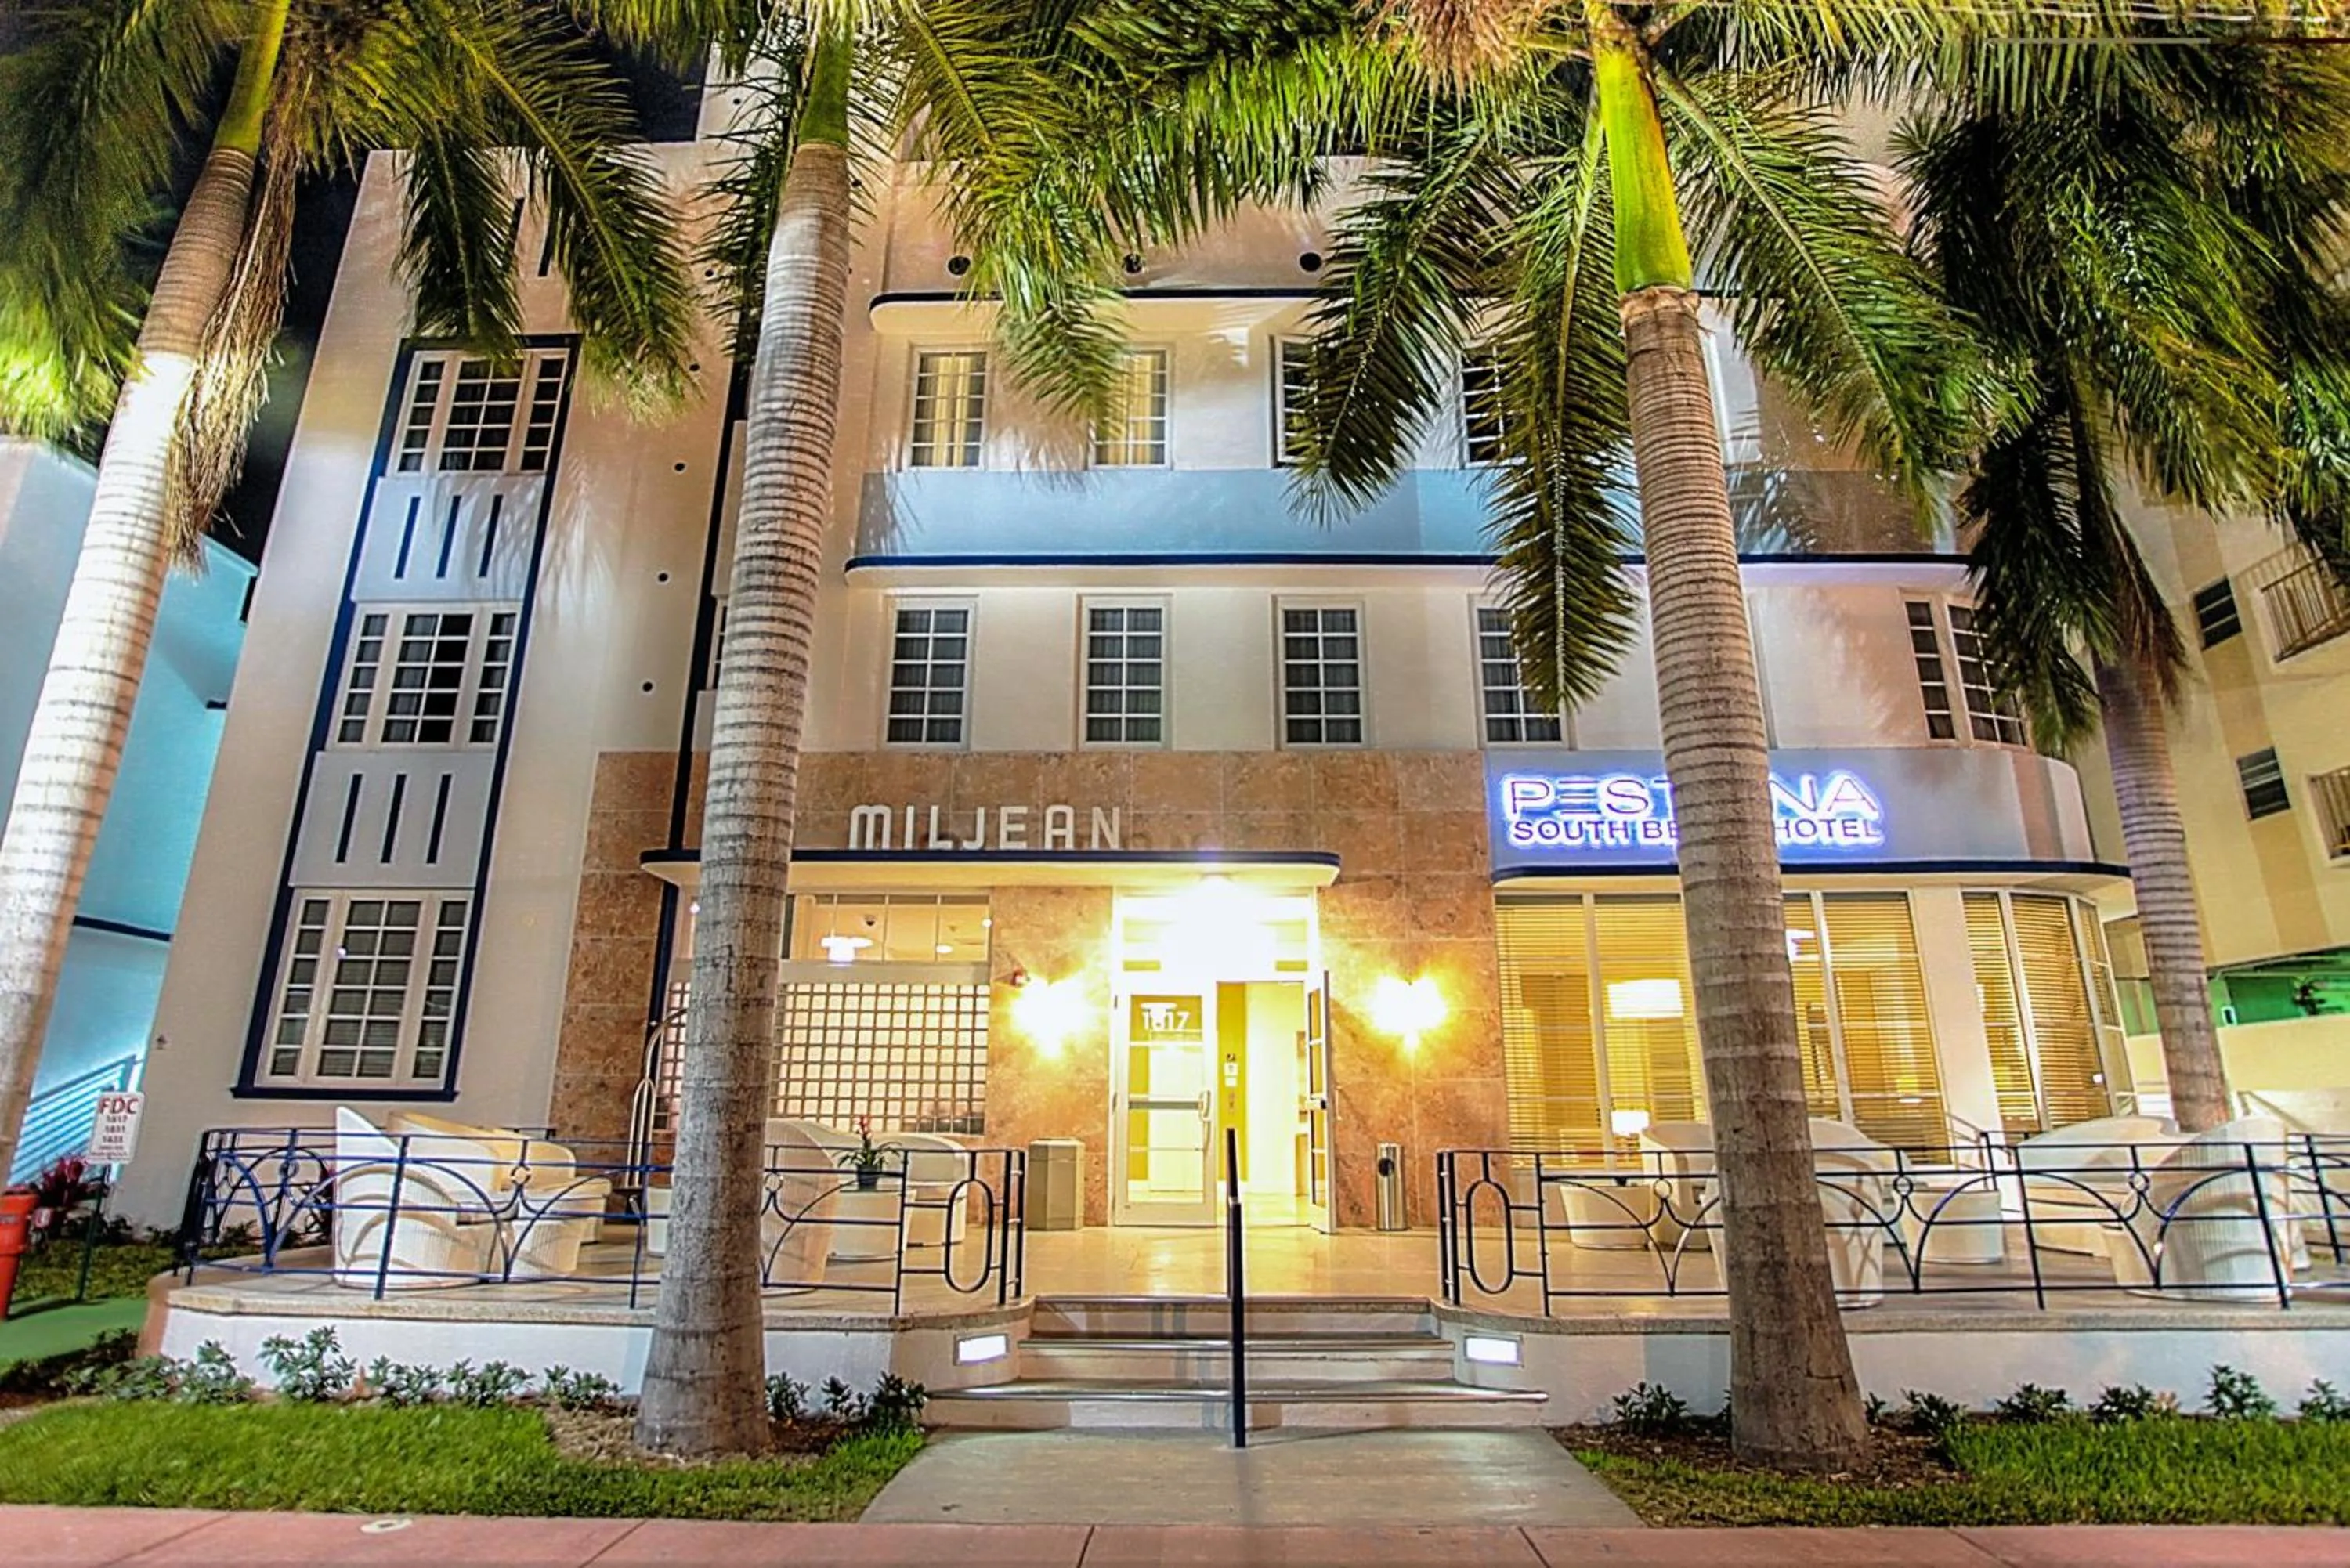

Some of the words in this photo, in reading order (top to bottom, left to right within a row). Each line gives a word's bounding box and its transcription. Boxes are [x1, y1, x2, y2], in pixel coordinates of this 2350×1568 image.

[1506, 776, 1881, 817] PESNA
[848, 804, 1121, 850] MILJEAN
[1512, 819, 1631, 841] SOUTH
[1773, 818, 1882, 840] HOTEL
[99, 1097, 138, 1114] FDC
